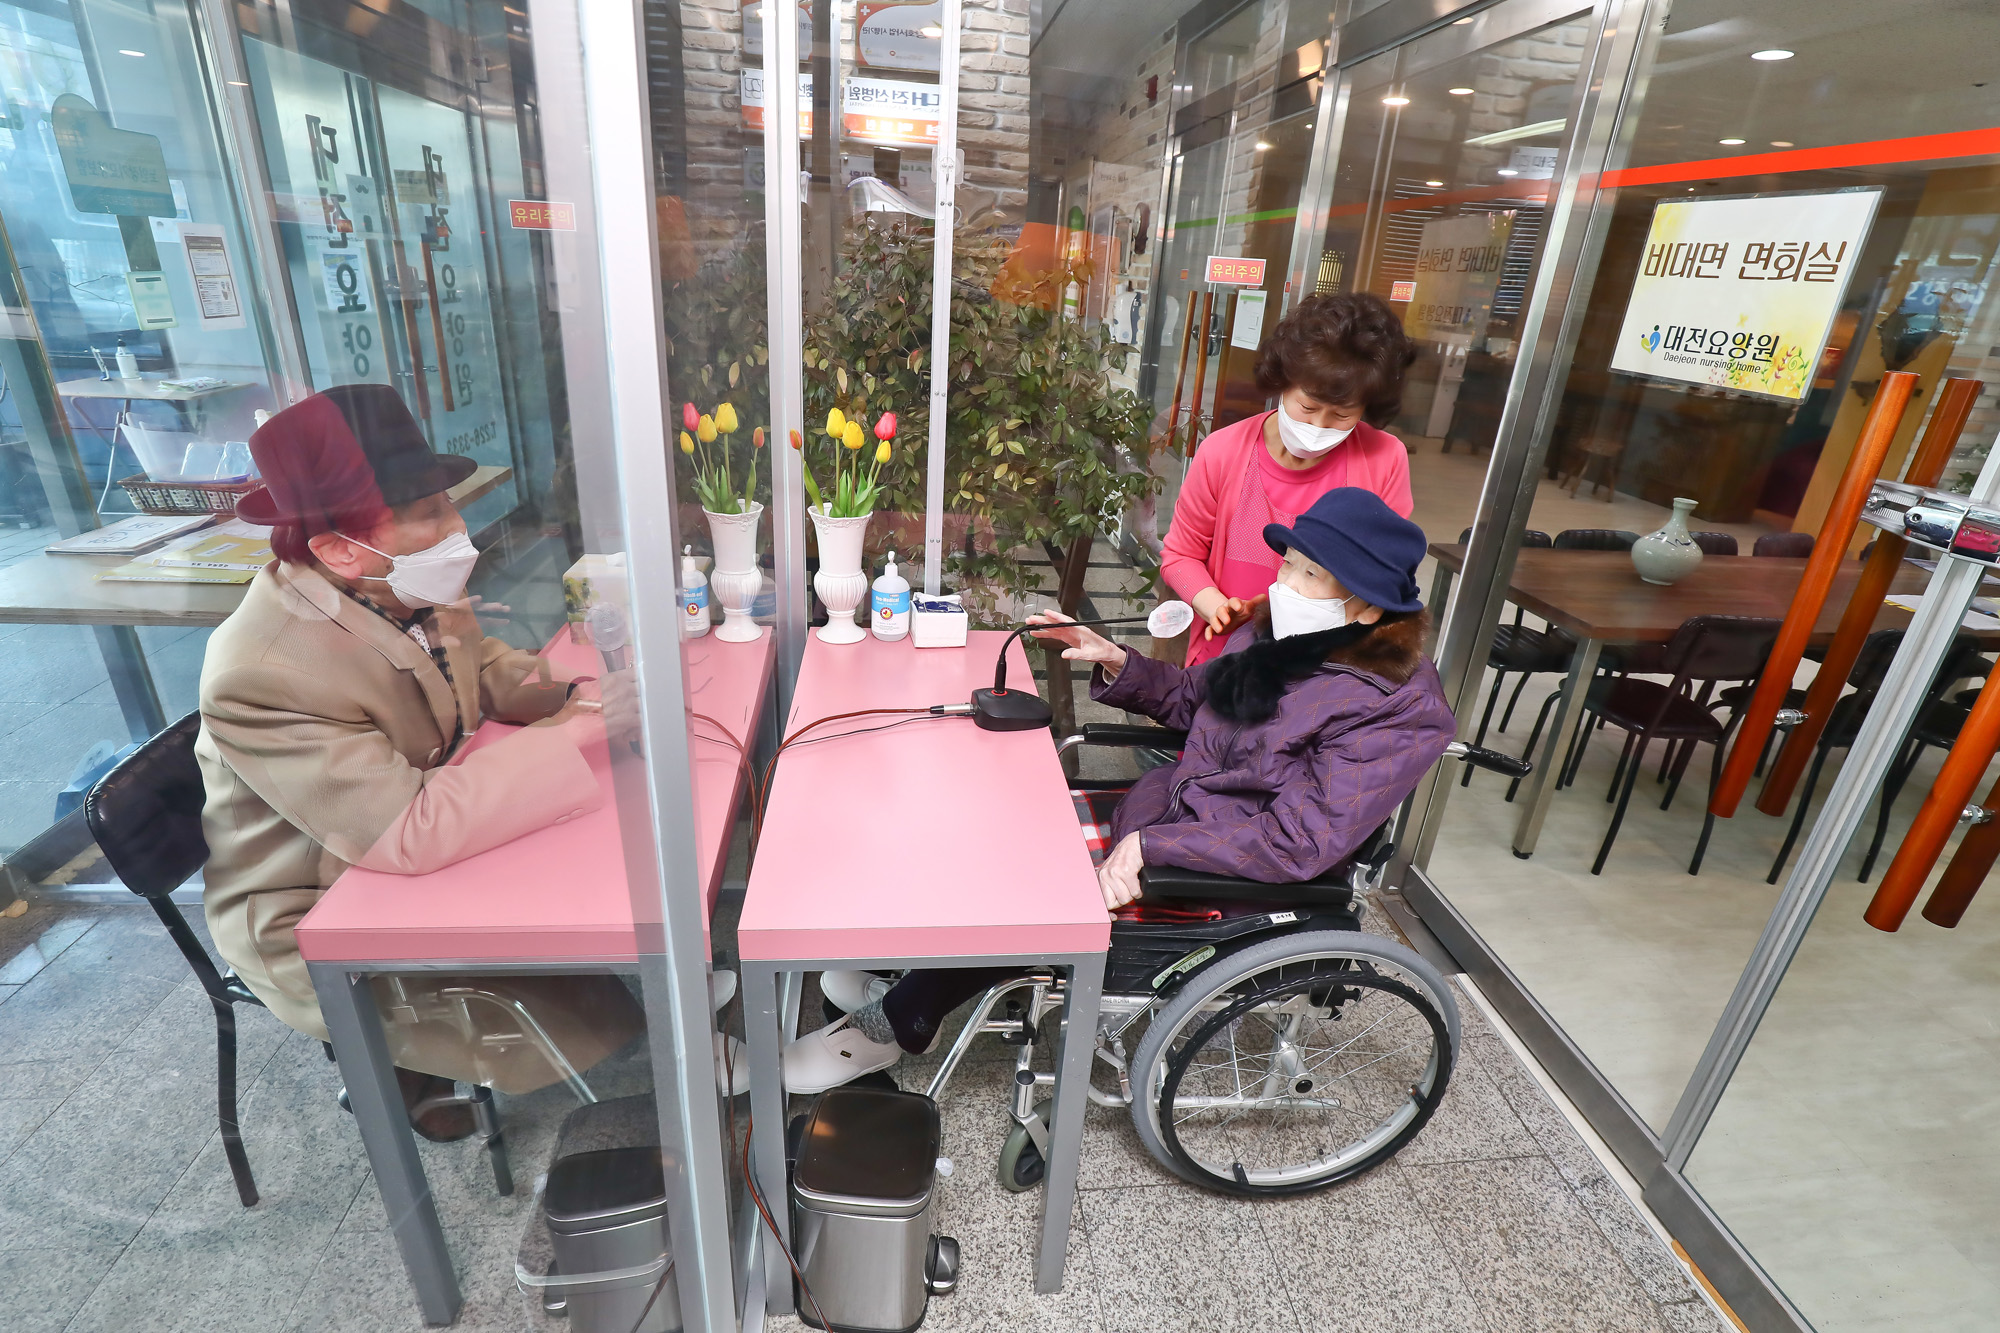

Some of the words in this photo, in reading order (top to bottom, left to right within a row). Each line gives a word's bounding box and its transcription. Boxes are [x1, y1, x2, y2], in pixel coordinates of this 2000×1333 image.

[514, 207, 571, 225] 유리주의
[1212, 263, 1262, 280] 유리주의
[1643, 241, 1729, 279] 비대면
[1738, 240, 1848, 283] 면회실
[1663, 325, 1780, 363] 대전요양원
[1663, 351, 1697, 365] Daejeon
[1700, 357, 1733, 371] nursing
[1735, 361, 1761, 374] home
